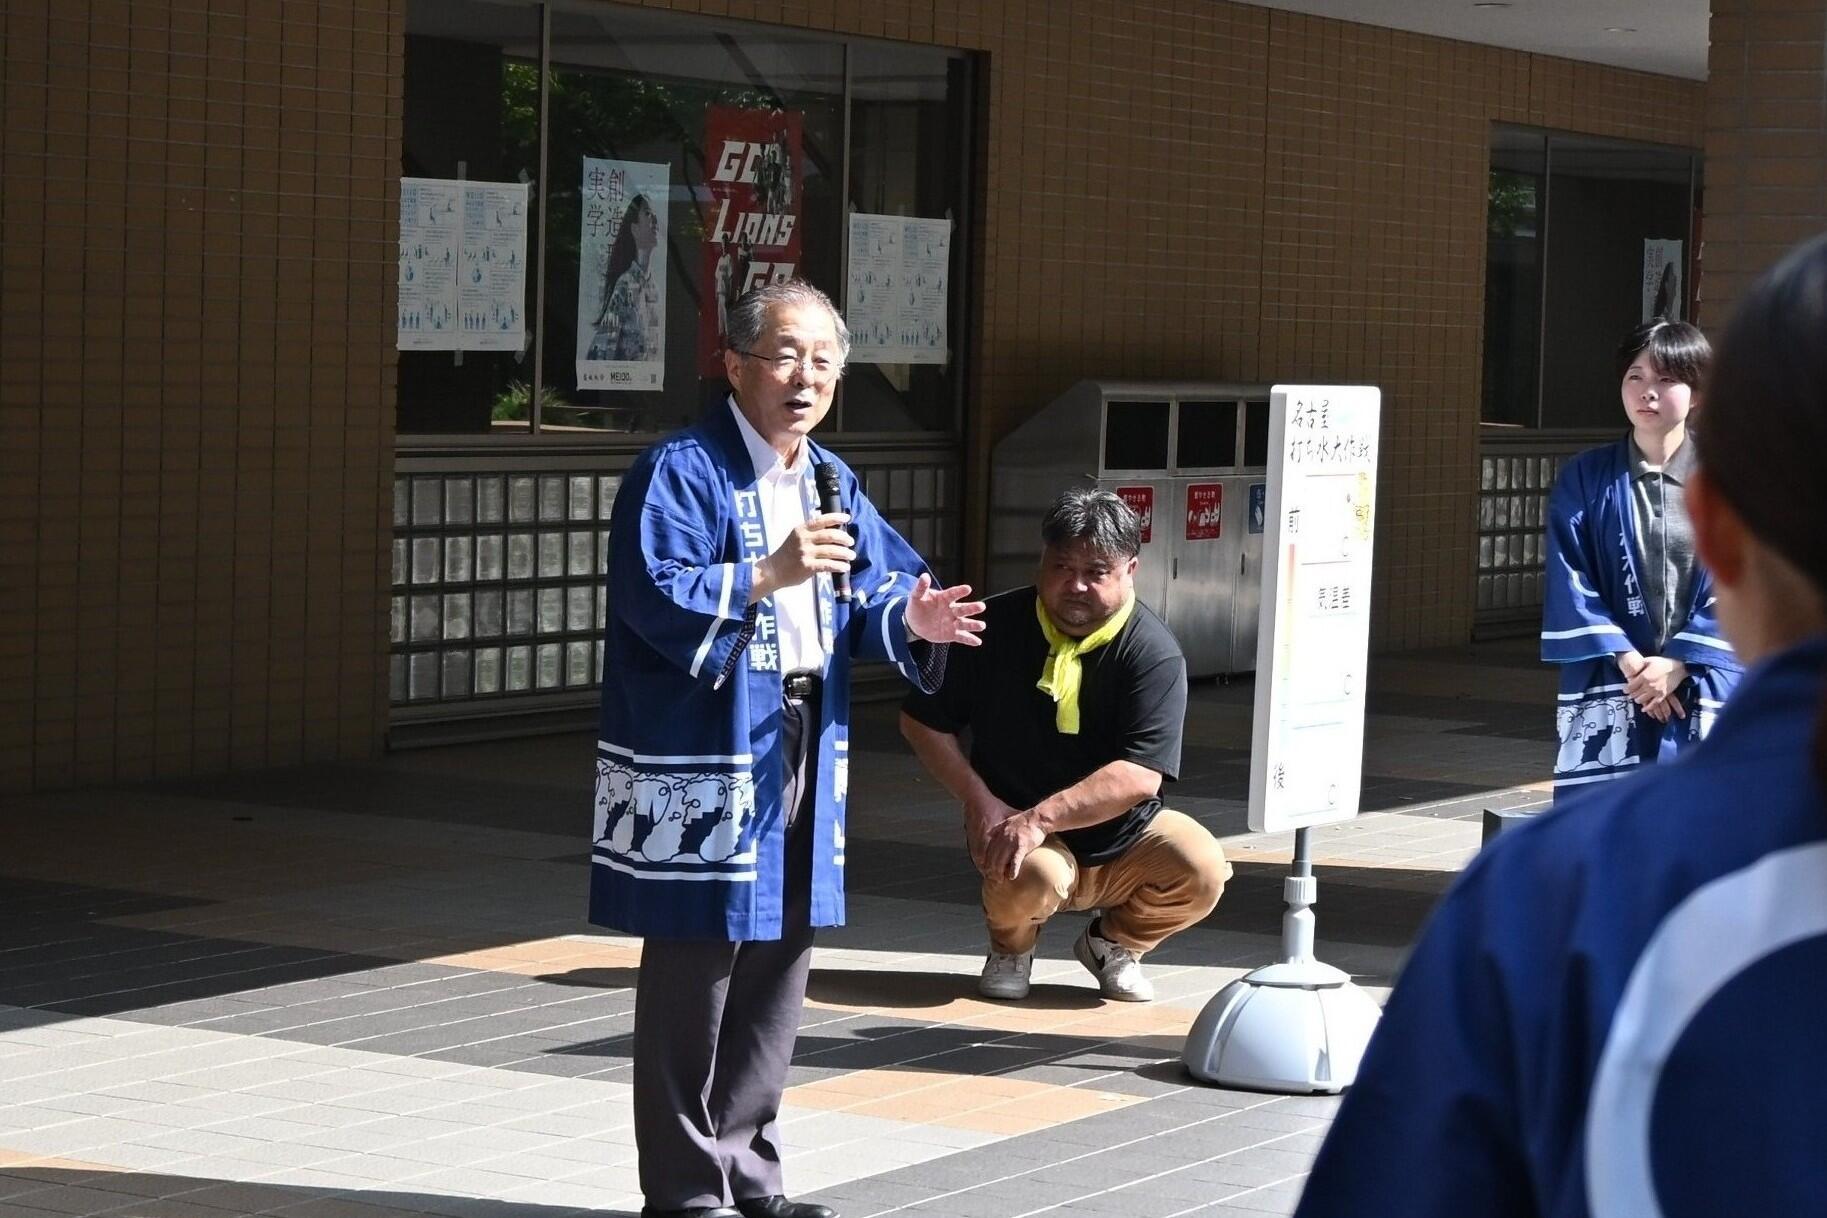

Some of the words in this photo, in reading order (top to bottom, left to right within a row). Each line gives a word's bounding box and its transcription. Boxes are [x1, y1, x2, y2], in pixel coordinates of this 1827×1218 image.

[587, 166, 605, 237] 実学
[709, 198, 796, 246] LIONS
[733, 490, 778, 671] 打ち作戦
